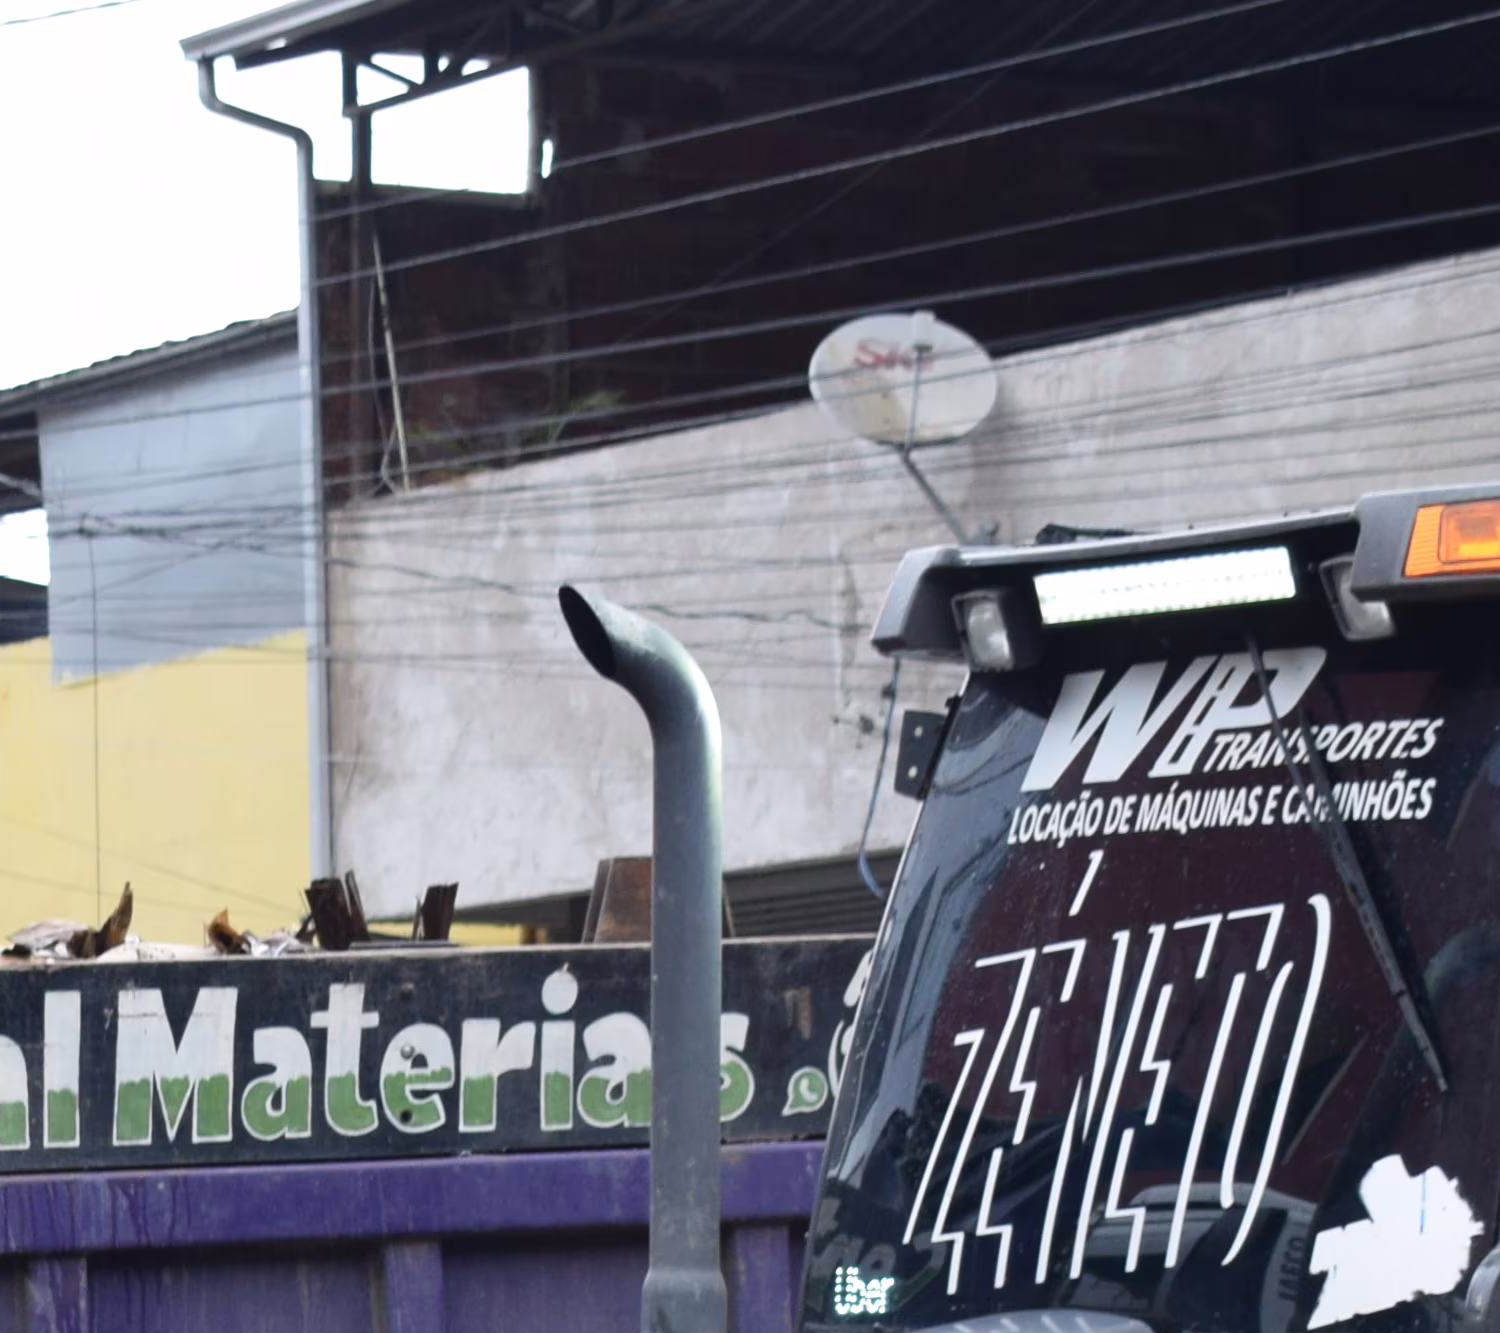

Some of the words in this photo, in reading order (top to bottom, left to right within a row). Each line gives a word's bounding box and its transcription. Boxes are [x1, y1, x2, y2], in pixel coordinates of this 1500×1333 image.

[1020, 647, 1327, 792] WP
[1203, 718, 1444, 773] TRANSPORTES
[1007, 790, 1102, 849] LOCAÇÃO
[1103, 795, 1131, 835] DE
[1134, 781, 1259, 835] MÁQUINAS
[1262, 786, 1278, 825] E
[1282, 770, 1437, 824] CAMINHÕES
